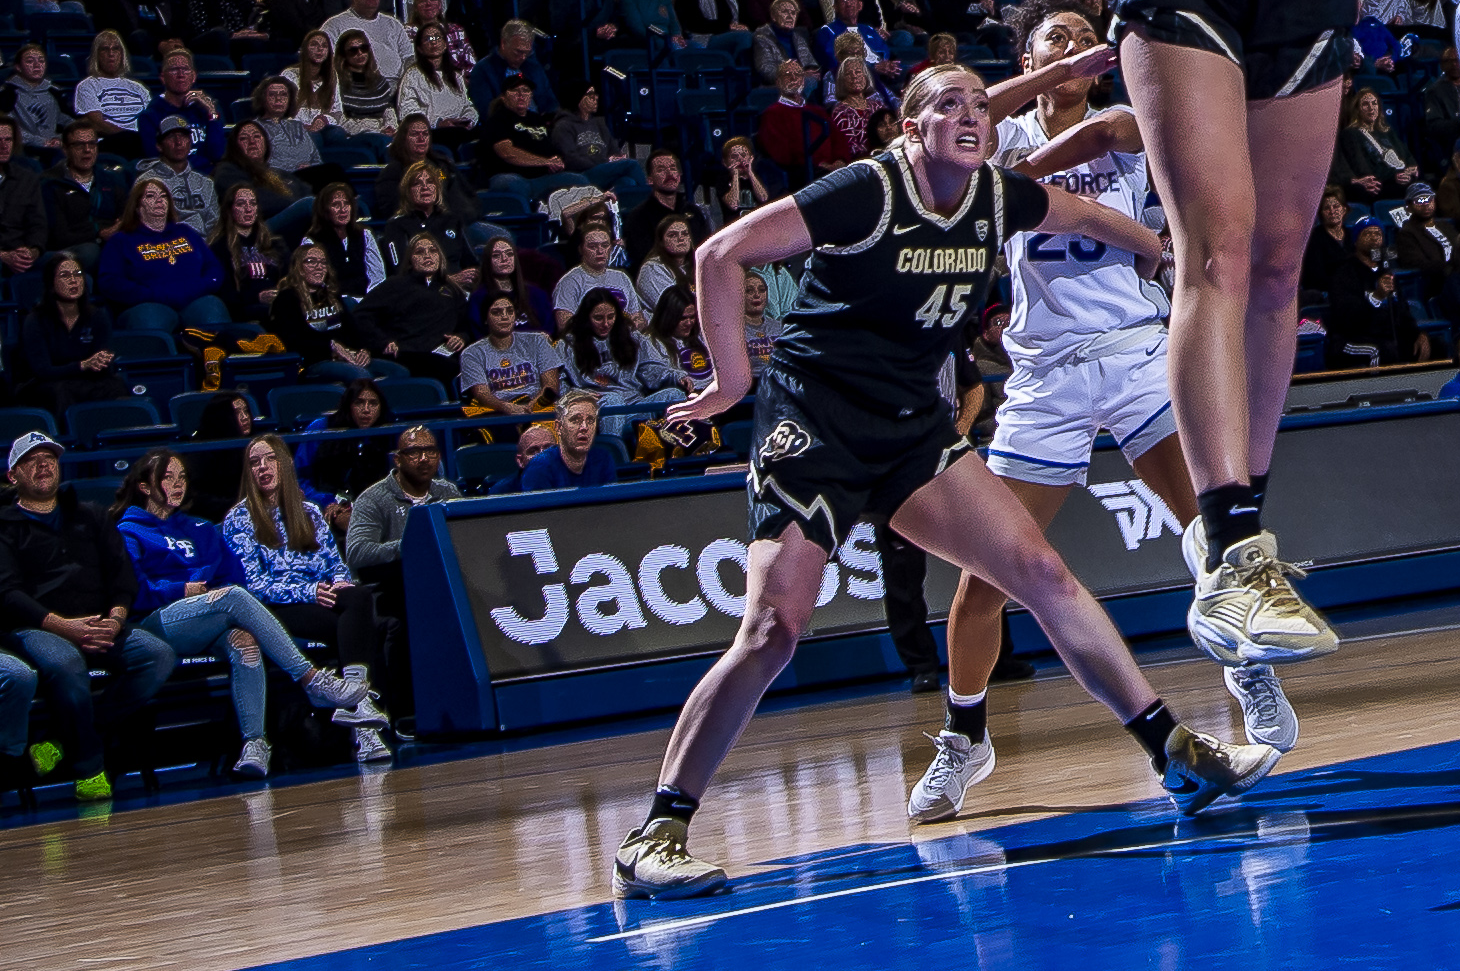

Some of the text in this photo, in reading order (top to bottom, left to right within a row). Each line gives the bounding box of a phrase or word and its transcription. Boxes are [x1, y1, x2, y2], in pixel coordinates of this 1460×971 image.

[896, 248, 987, 274] COLORADO
[915, 284, 973, 329] 45
[490, 522, 887, 646] Jacos
